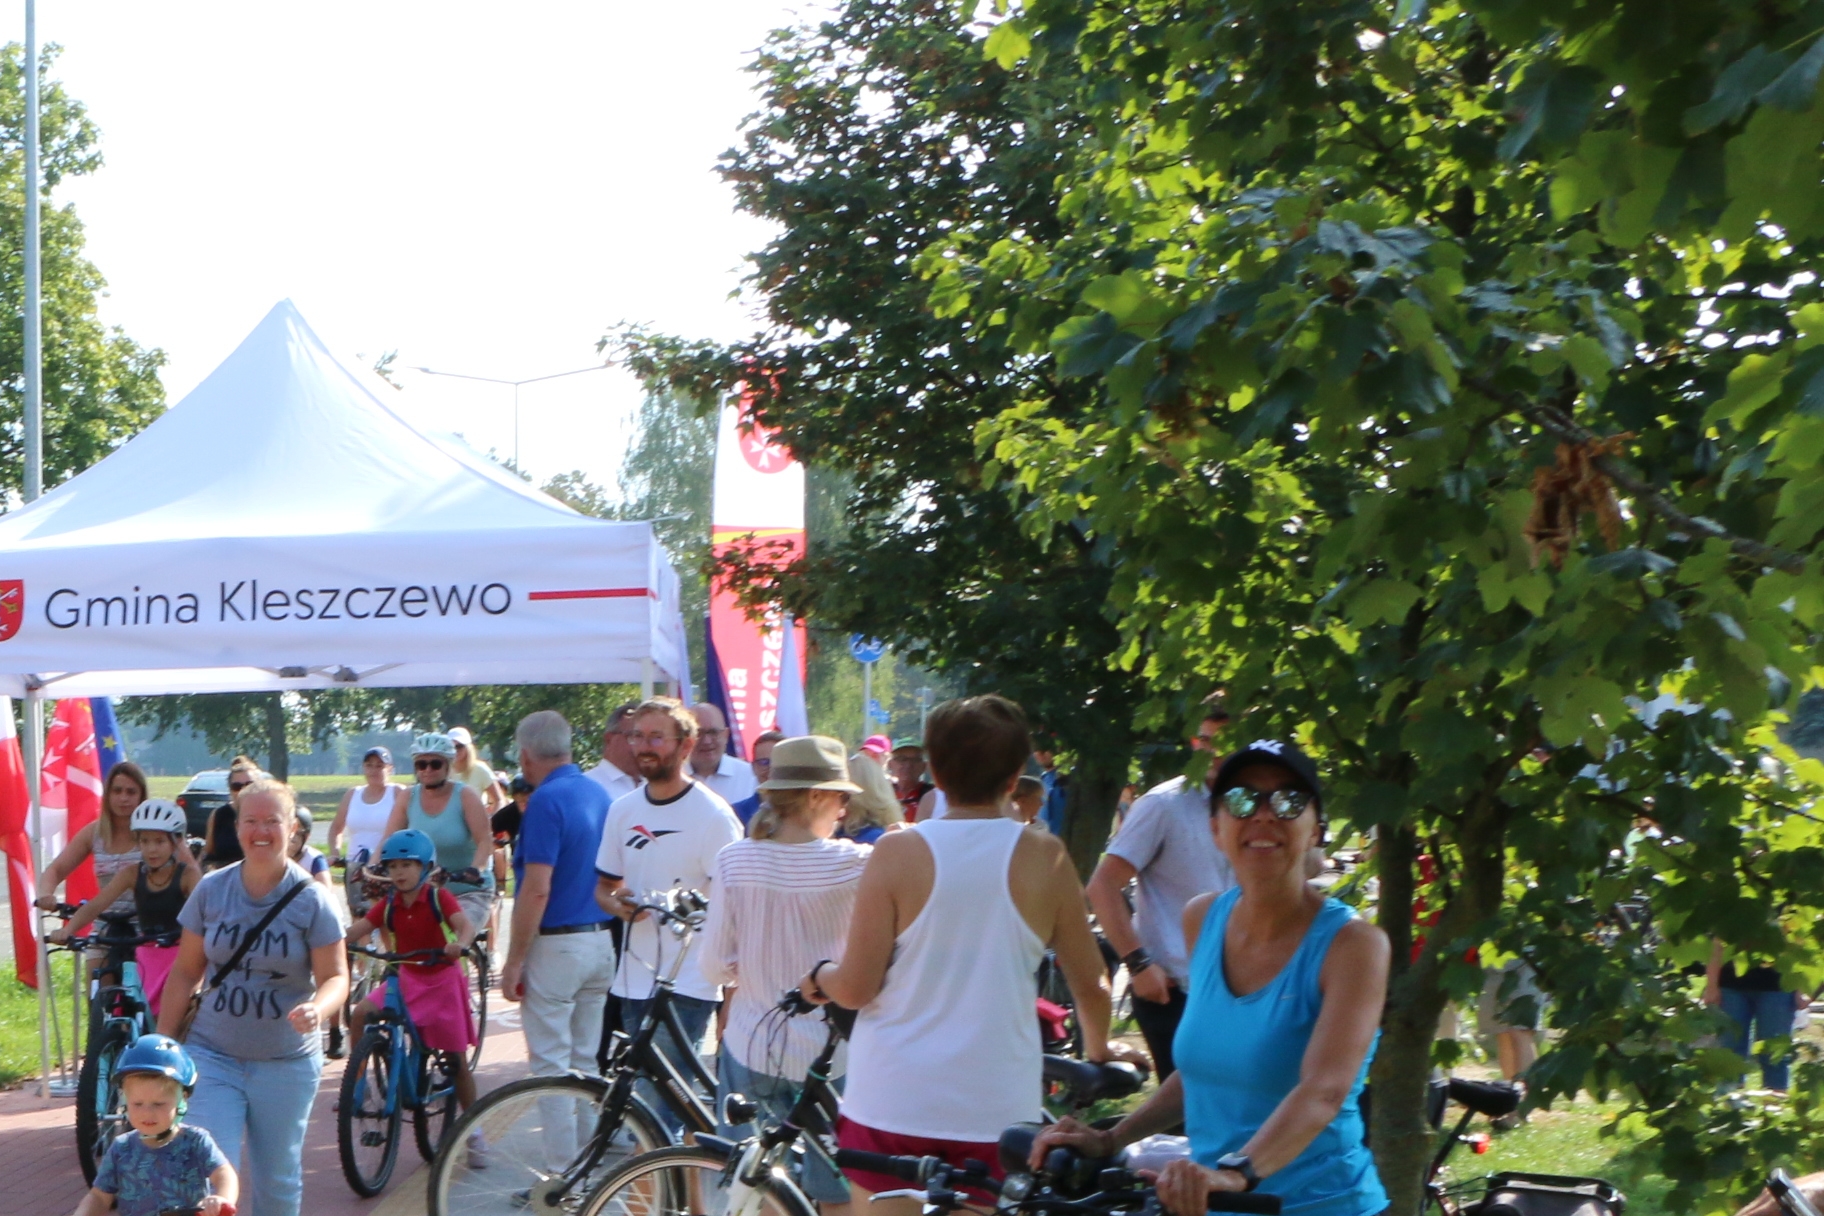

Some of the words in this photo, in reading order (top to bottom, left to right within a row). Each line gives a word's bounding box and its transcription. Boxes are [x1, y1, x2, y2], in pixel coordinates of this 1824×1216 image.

[44, 585, 199, 630] Gmina
[219, 579, 513, 624] Kleszczewo
[213, 983, 283, 1020] BOYS
